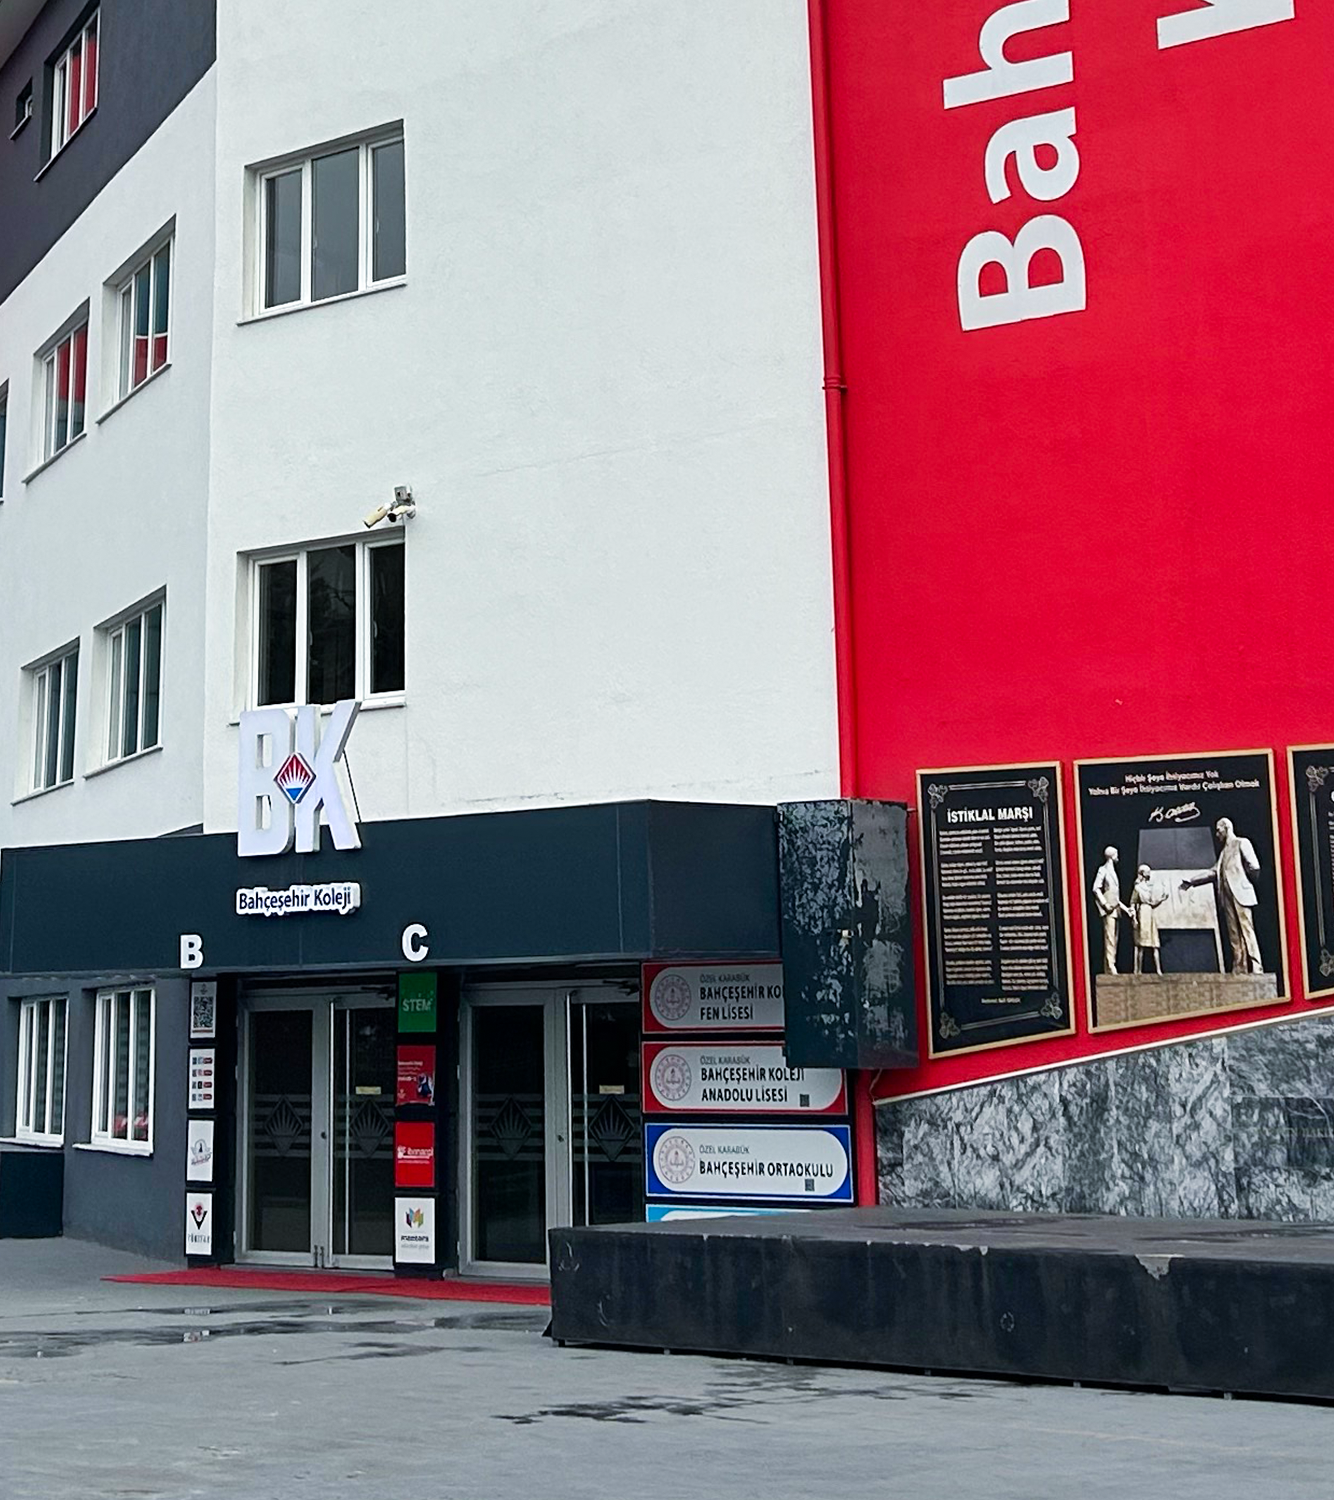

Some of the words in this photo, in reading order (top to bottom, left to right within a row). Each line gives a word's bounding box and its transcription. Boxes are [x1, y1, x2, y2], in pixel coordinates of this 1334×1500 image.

[238, 700, 362, 857] BK
[947, 807, 995, 823] İSTİKLAL
[998, 806, 1033, 822] MARŞI
[239, 888, 309, 911] Bahçeşehir
[314, 886, 352, 906] Koleji
[180, 934, 204, 969] B
[402, 923, 429, 962] C
[700, 982, 764, 1002] BAHÇEŞEHİR
[767, 985, 783, 999] KO
[402, 998, 432, 1012] STEM
[700, 1007, 719, 1020] FEN
[722, 1003, 753, 1020] LİSESİ
[701, 1064, 765, 1084] BAHÇEŞEHİR
[702, 1088, 753, 1102] ANADOLU
[756, 1086, 788, 1102] LİSESİ
[700, 1159, 765, 1179] BAHÇEŞEHİR
[768, 1162, 833, 1178] ORTAOKULU
